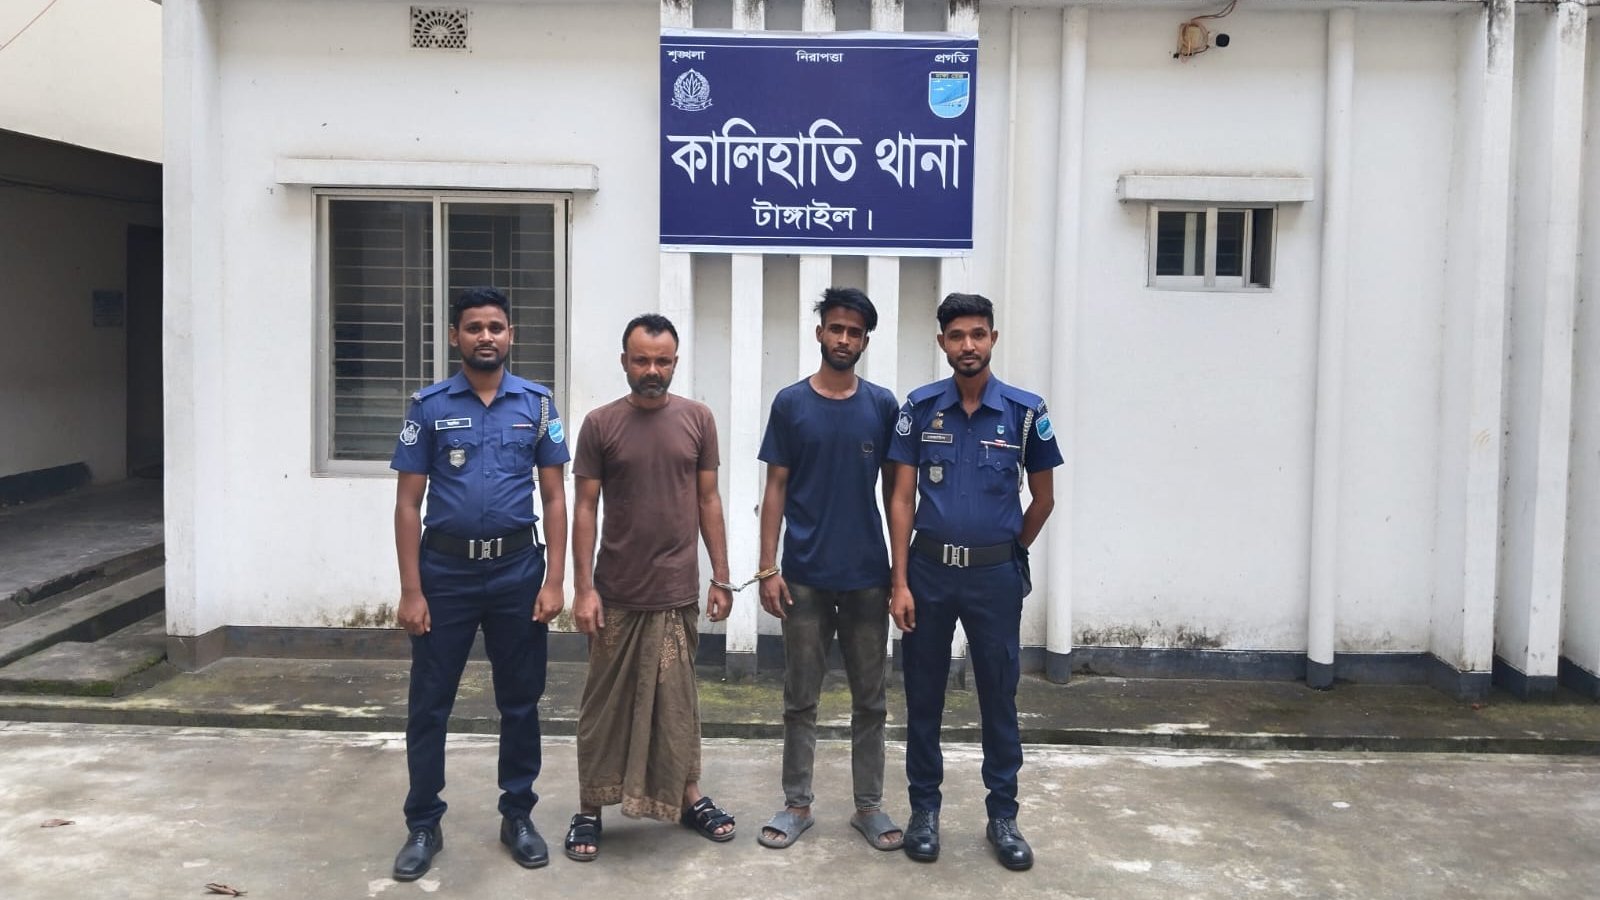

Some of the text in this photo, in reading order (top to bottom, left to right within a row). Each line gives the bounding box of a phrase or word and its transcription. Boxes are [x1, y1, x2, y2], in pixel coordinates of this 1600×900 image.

[796, 50, 843, 62] নিরাপত্তা
[934, 51, 970, 64] প্রগতি
[666, 117, 968, 190] কালিহাতি থানা
